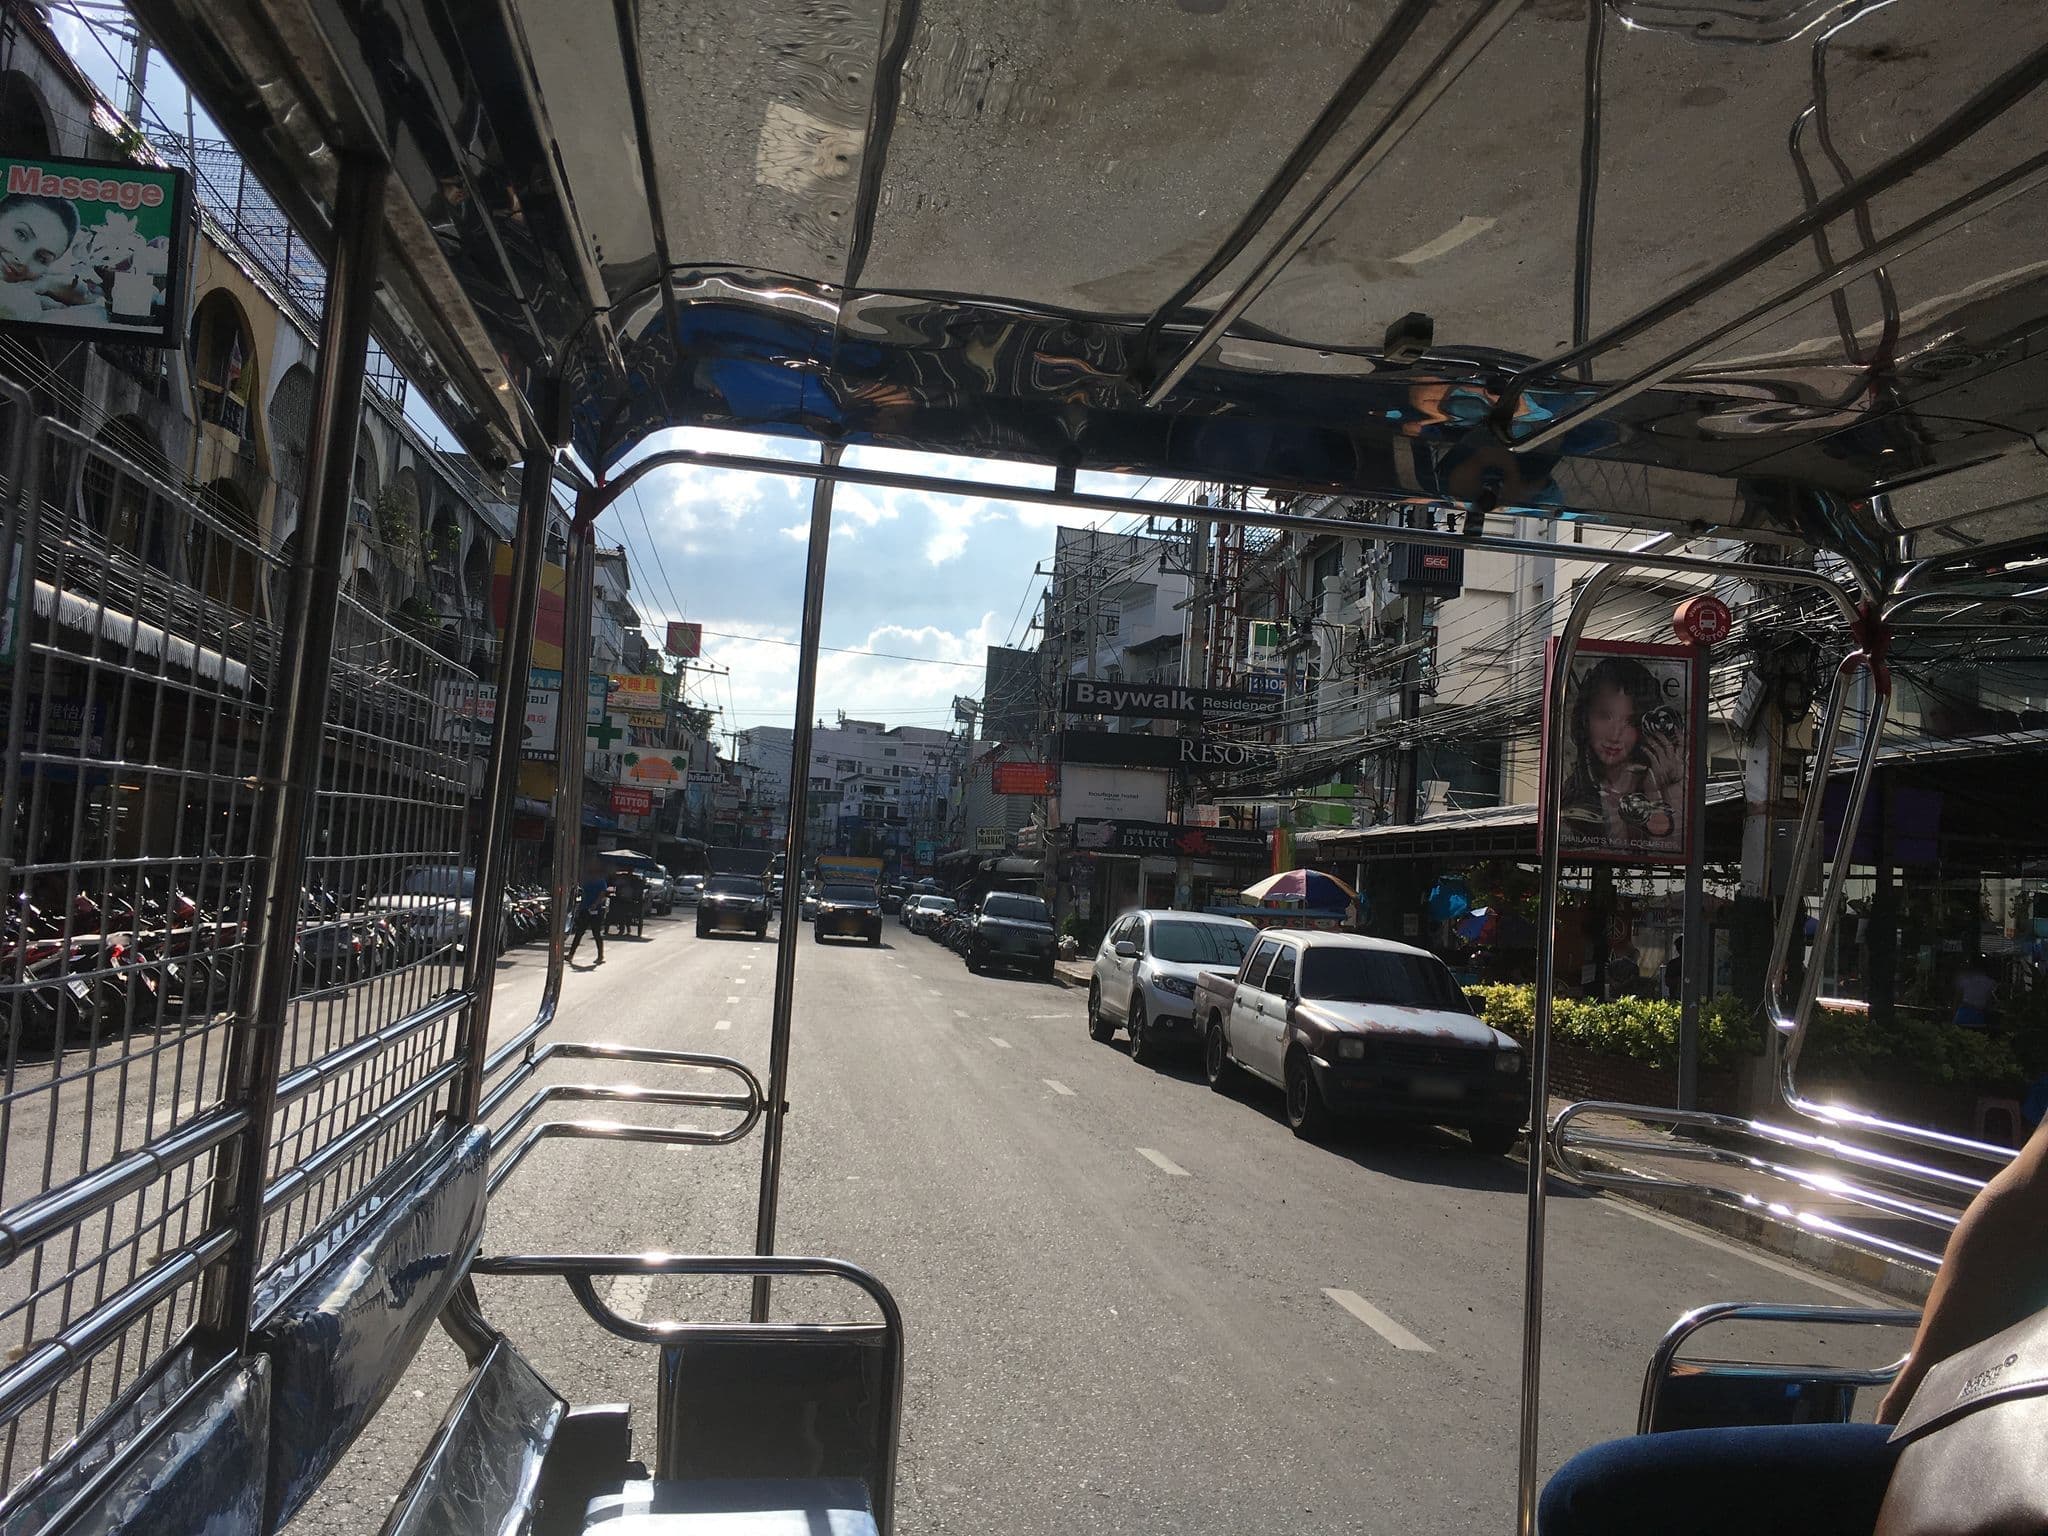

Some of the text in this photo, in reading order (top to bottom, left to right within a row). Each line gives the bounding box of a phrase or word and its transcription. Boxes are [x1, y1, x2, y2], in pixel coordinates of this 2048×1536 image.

[7, 165, 164, 210] Massage
[1425, 557, 1447, 567] SEC
[1076, 682, 1275, 712] Baywalk Residence
[1179, 738, 1267, 765] RESOR
[614, 795, 649, 808] TATTOO
